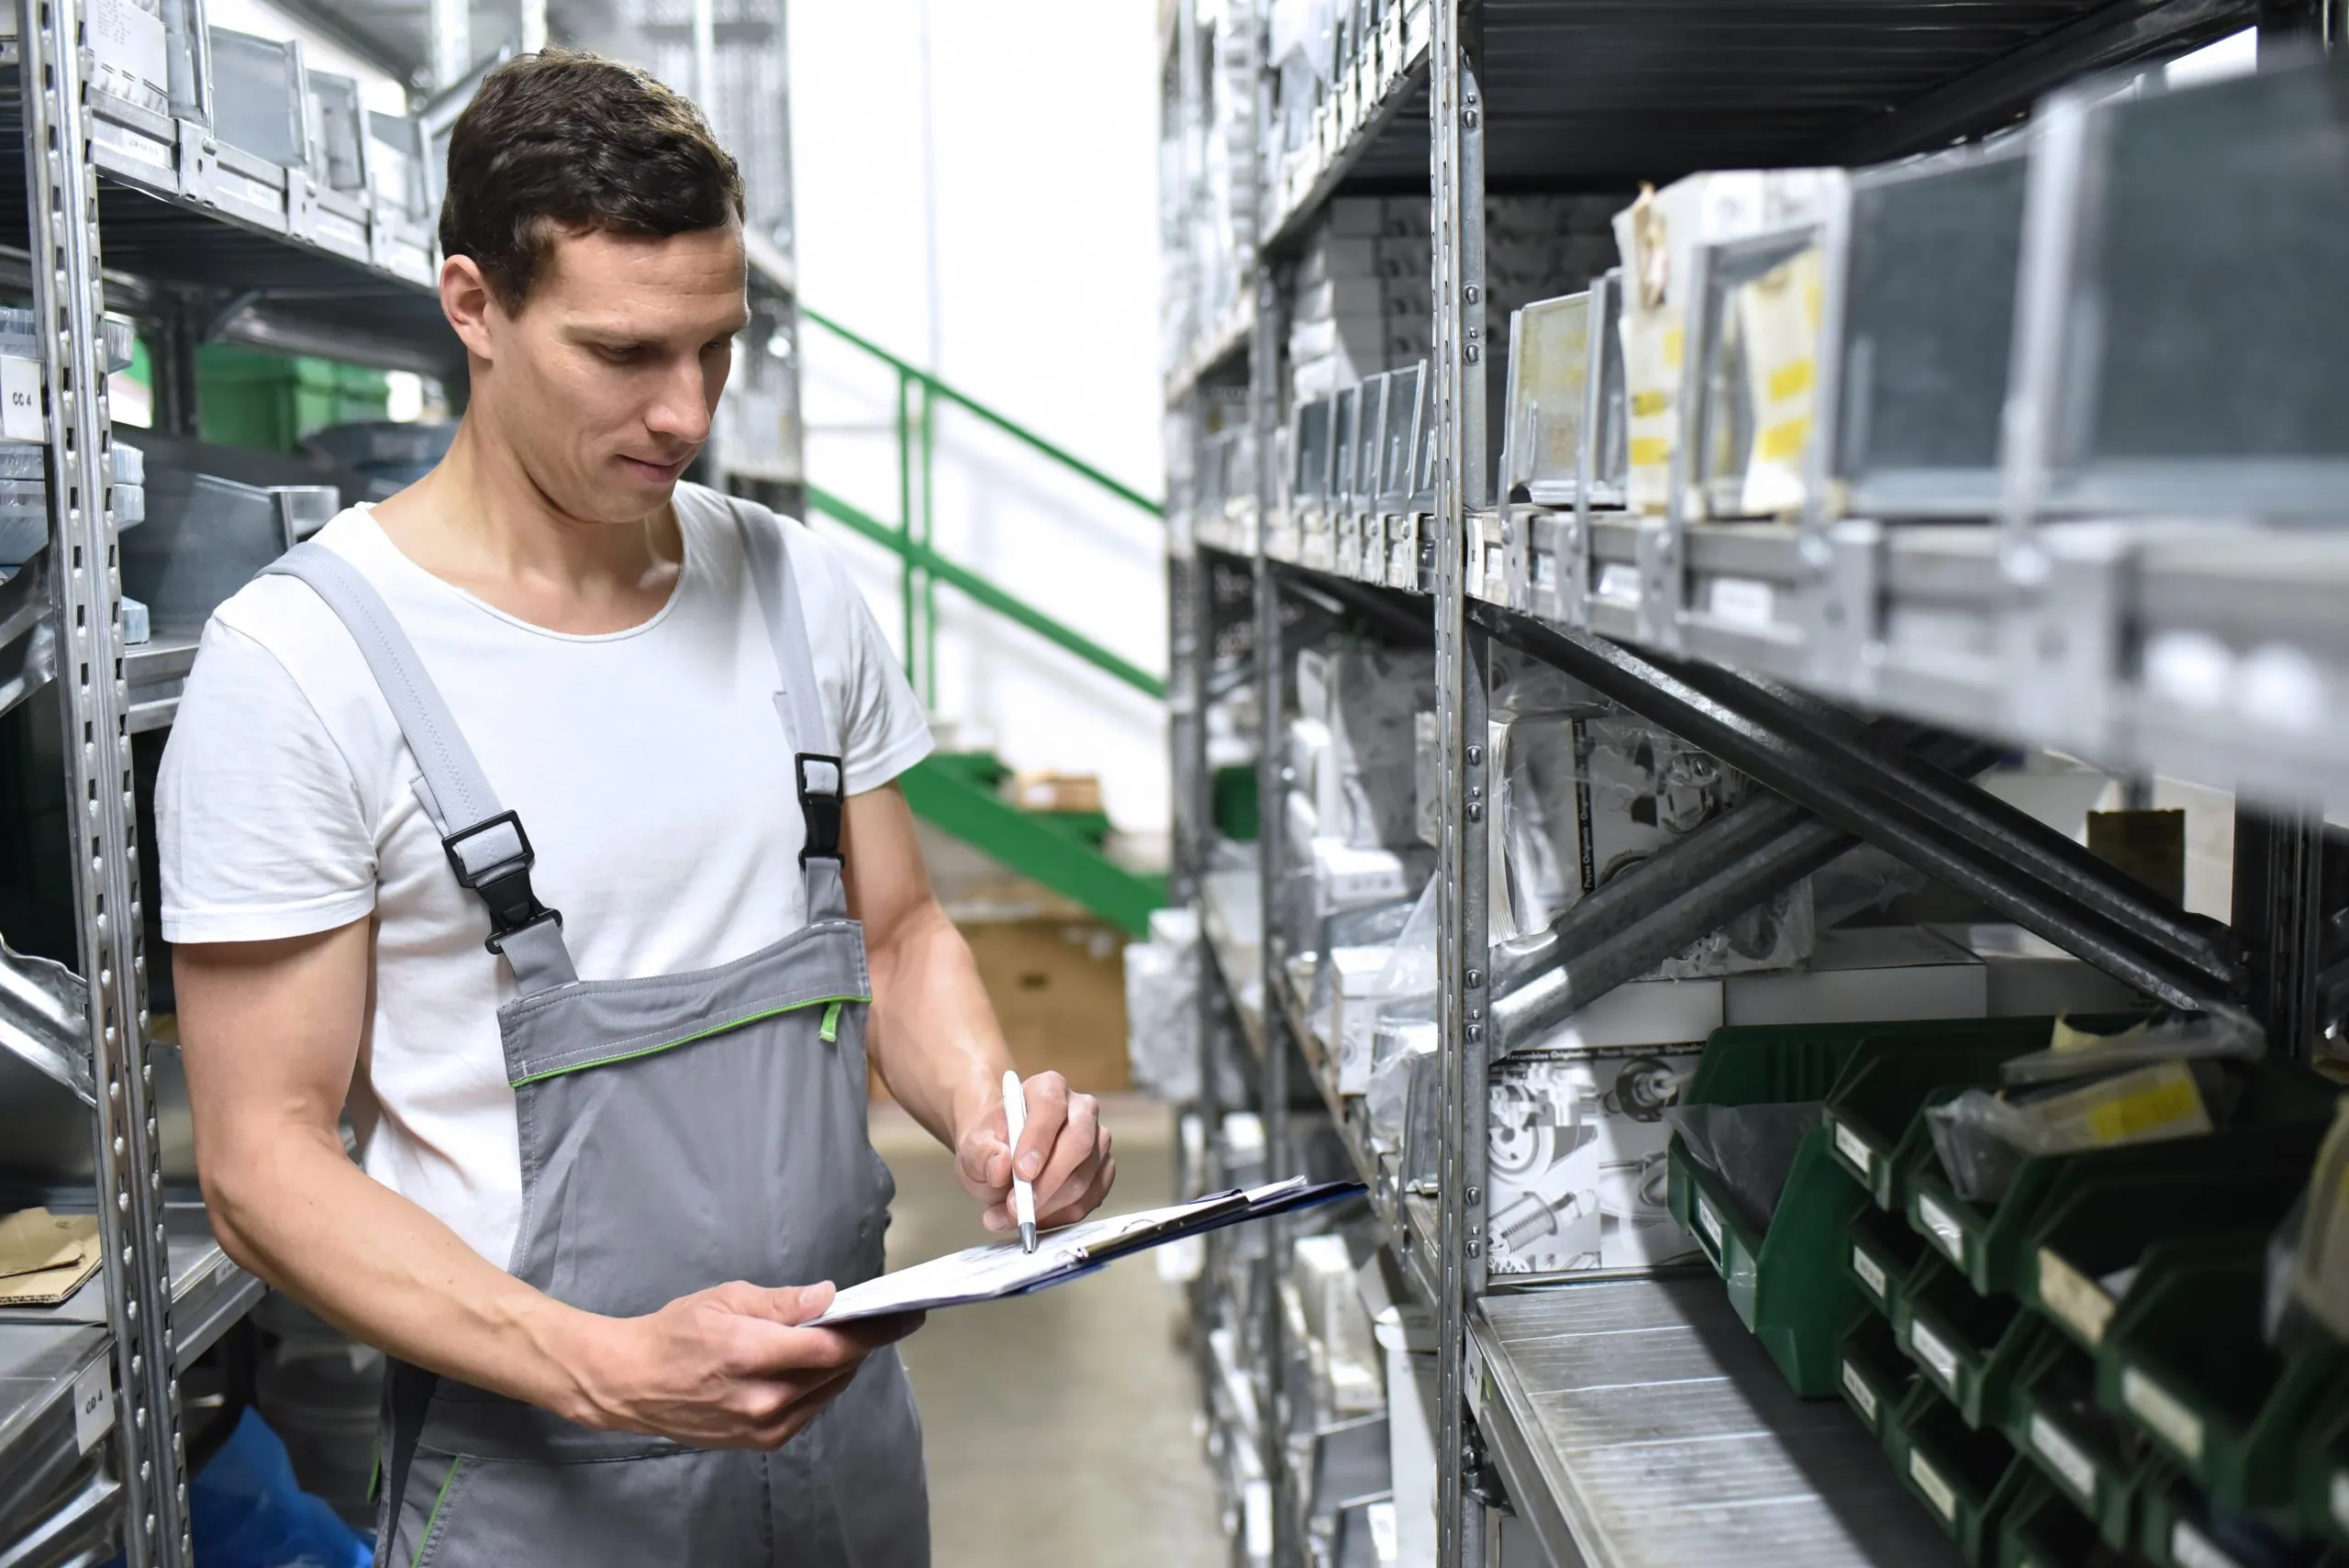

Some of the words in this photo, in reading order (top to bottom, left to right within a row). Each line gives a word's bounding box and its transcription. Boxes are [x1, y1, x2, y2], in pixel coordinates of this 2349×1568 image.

[13, 392, 24, 406] CC
[27, 394, 31, 407] 4
[86, 1396, 96, 1414] CD
[98, 1388, 103, 1402] 4
